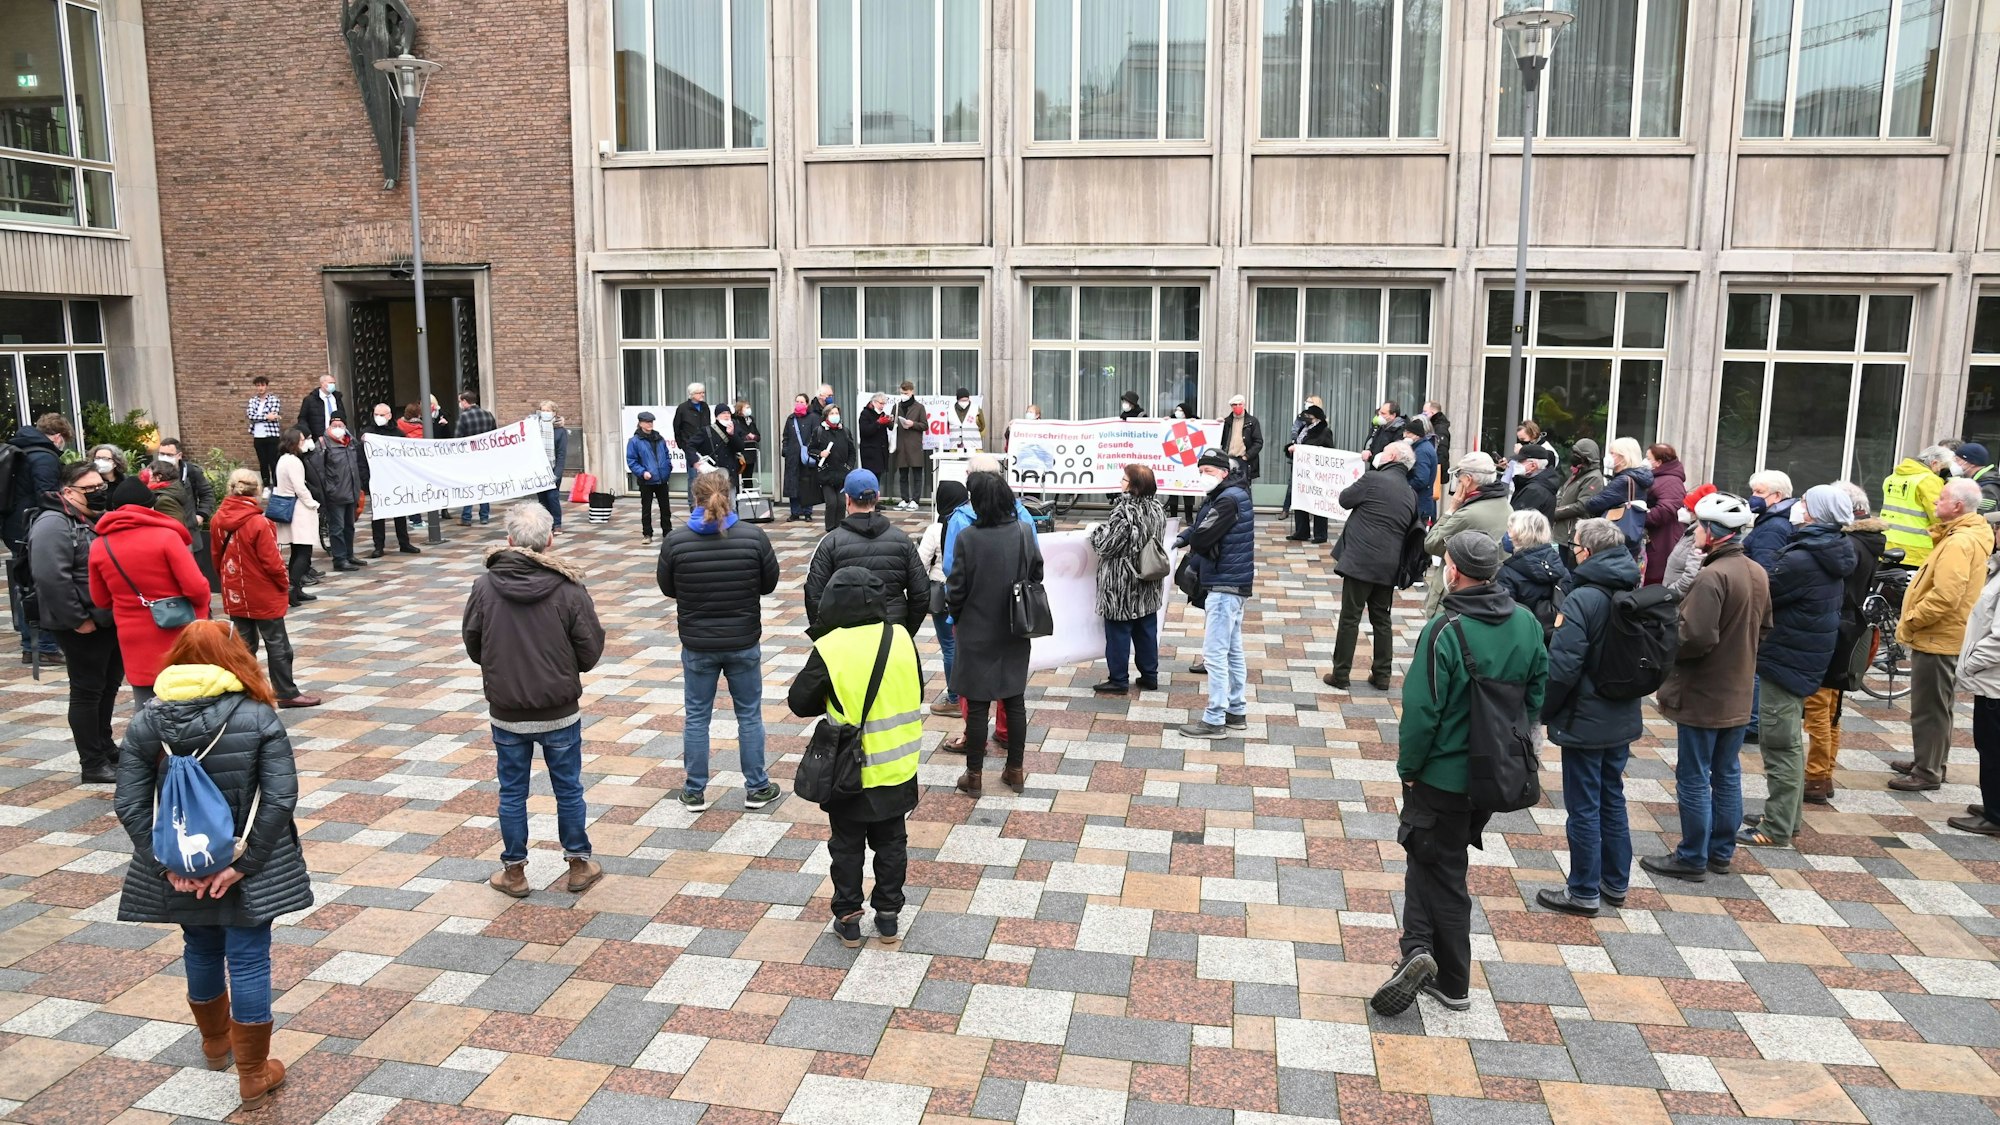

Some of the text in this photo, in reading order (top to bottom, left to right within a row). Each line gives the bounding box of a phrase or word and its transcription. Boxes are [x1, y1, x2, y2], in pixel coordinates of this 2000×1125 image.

[1013, 431, 1079, 441] Unterschriften
[1098, 430, 1158, 439] Volksinitiative
[470, 438, 489, 452] muss
[1098, 441, 1134, 449] Gesunde
[1151, 464, 1175, 472] ALLE!
[372, 492, 391, 508] Die
[393, 483, 449, 508] Schließung
[452, 485, 475, 499] muss
[477, 473, 516, 500] gestoppt
